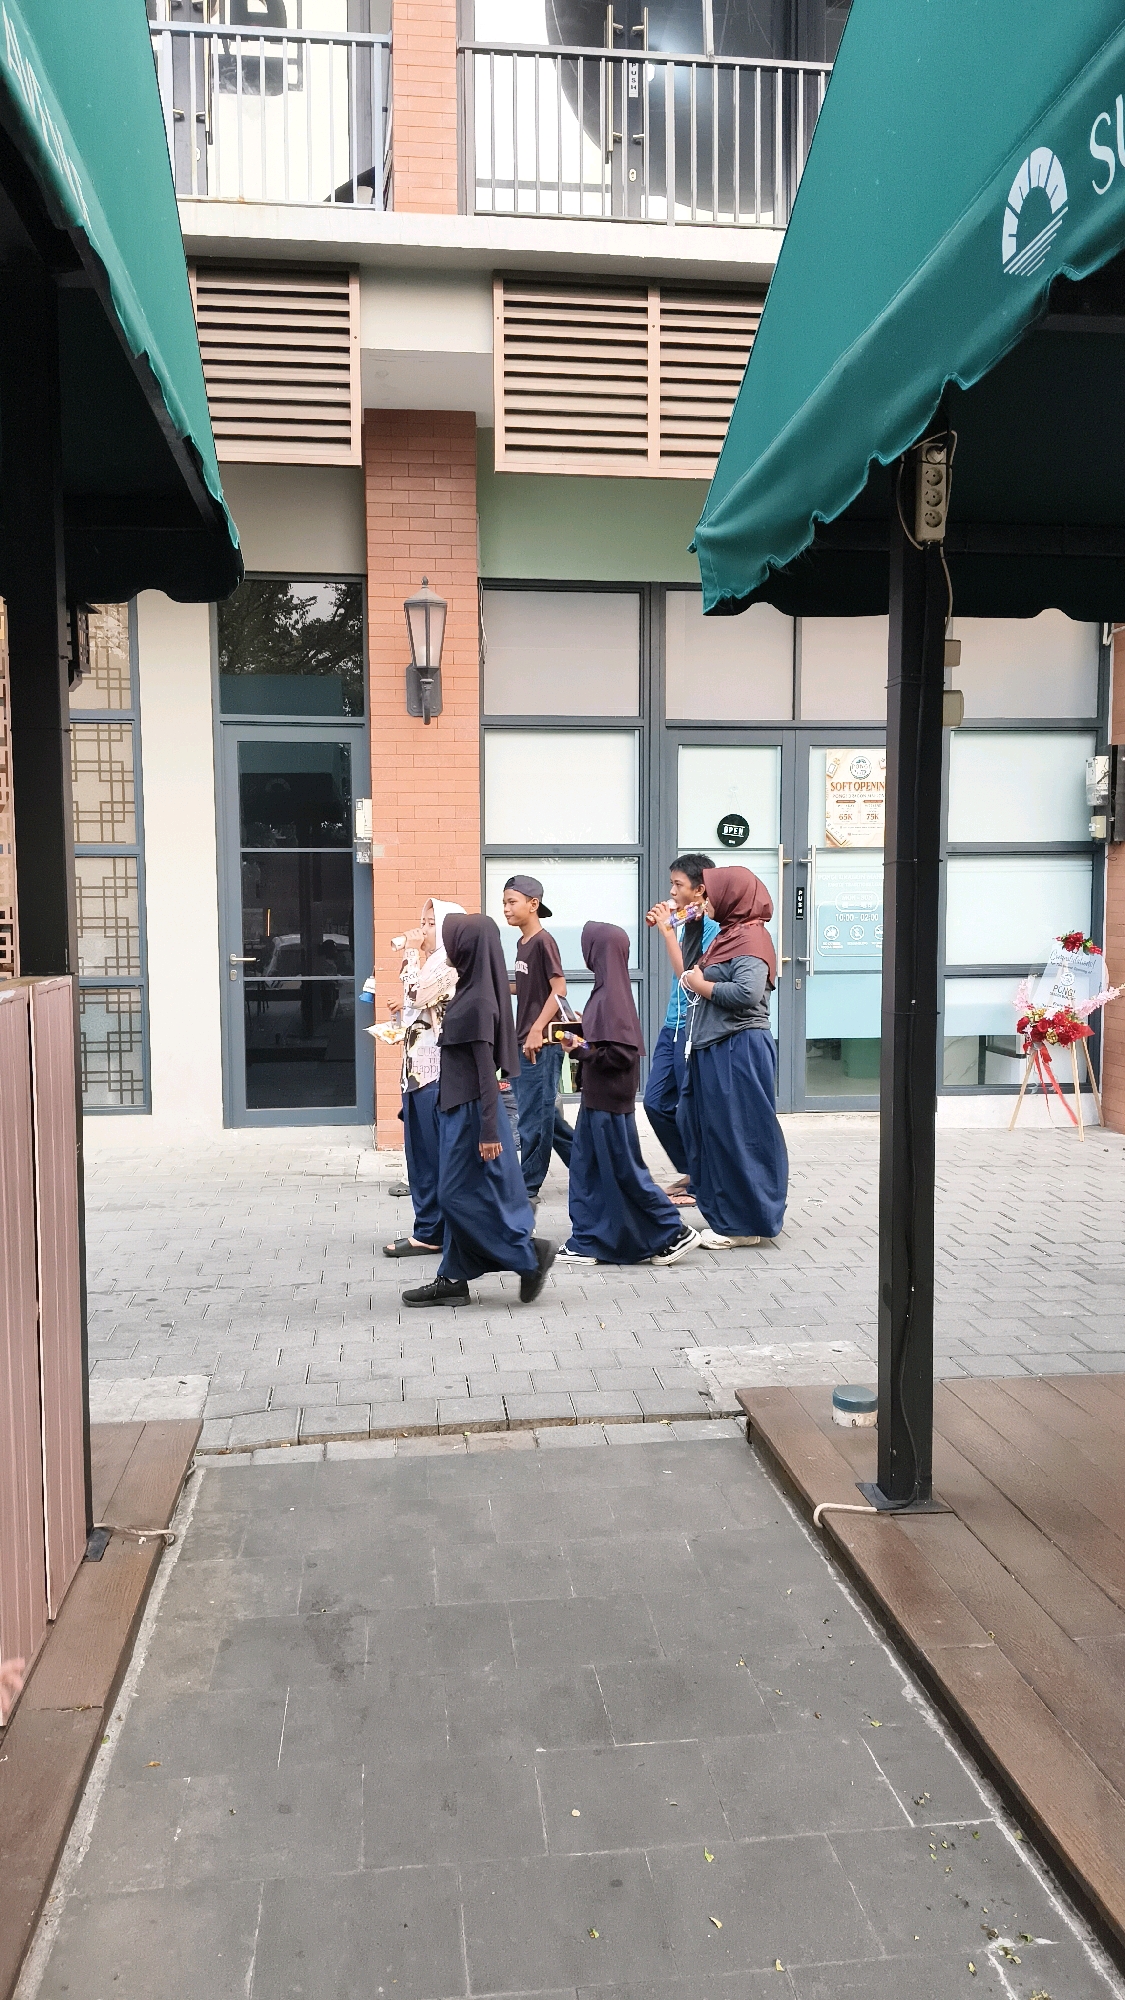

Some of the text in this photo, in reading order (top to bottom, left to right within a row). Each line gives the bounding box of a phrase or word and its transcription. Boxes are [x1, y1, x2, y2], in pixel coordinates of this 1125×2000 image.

[830, 781, 853, 792] SOFT
[838, 813, 853, 821] 65K
[866, 813, 879, 821] 75K
[723, 825, 744, 836] OPEN
[835, 913, 855, 922] 10:00
[860, 913, 879, 922] 02:00
